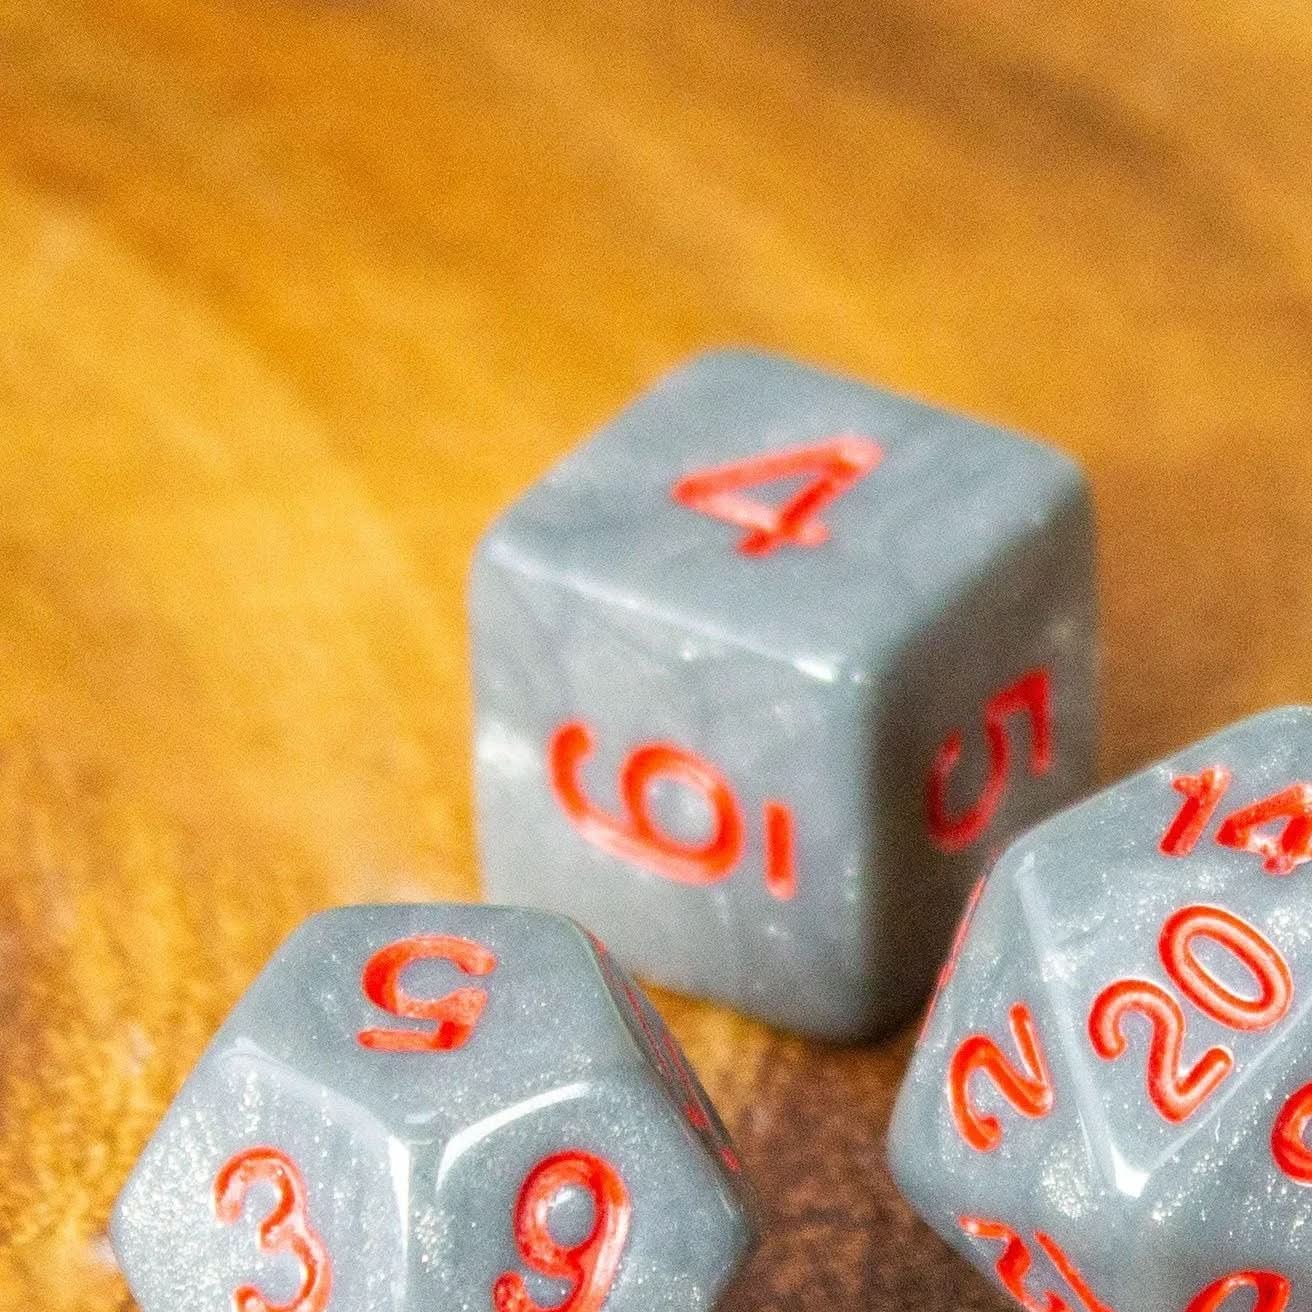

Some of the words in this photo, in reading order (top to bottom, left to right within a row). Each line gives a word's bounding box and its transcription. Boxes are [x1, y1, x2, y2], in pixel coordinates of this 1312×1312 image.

[671, 435, 884, 557] 4
[926, 664, 1054, 854] 5
[356, 934, 497, 1052] 5
[1086, 903, 1296, 1125] 20
[946, 1003, 1054, 1153] 2
